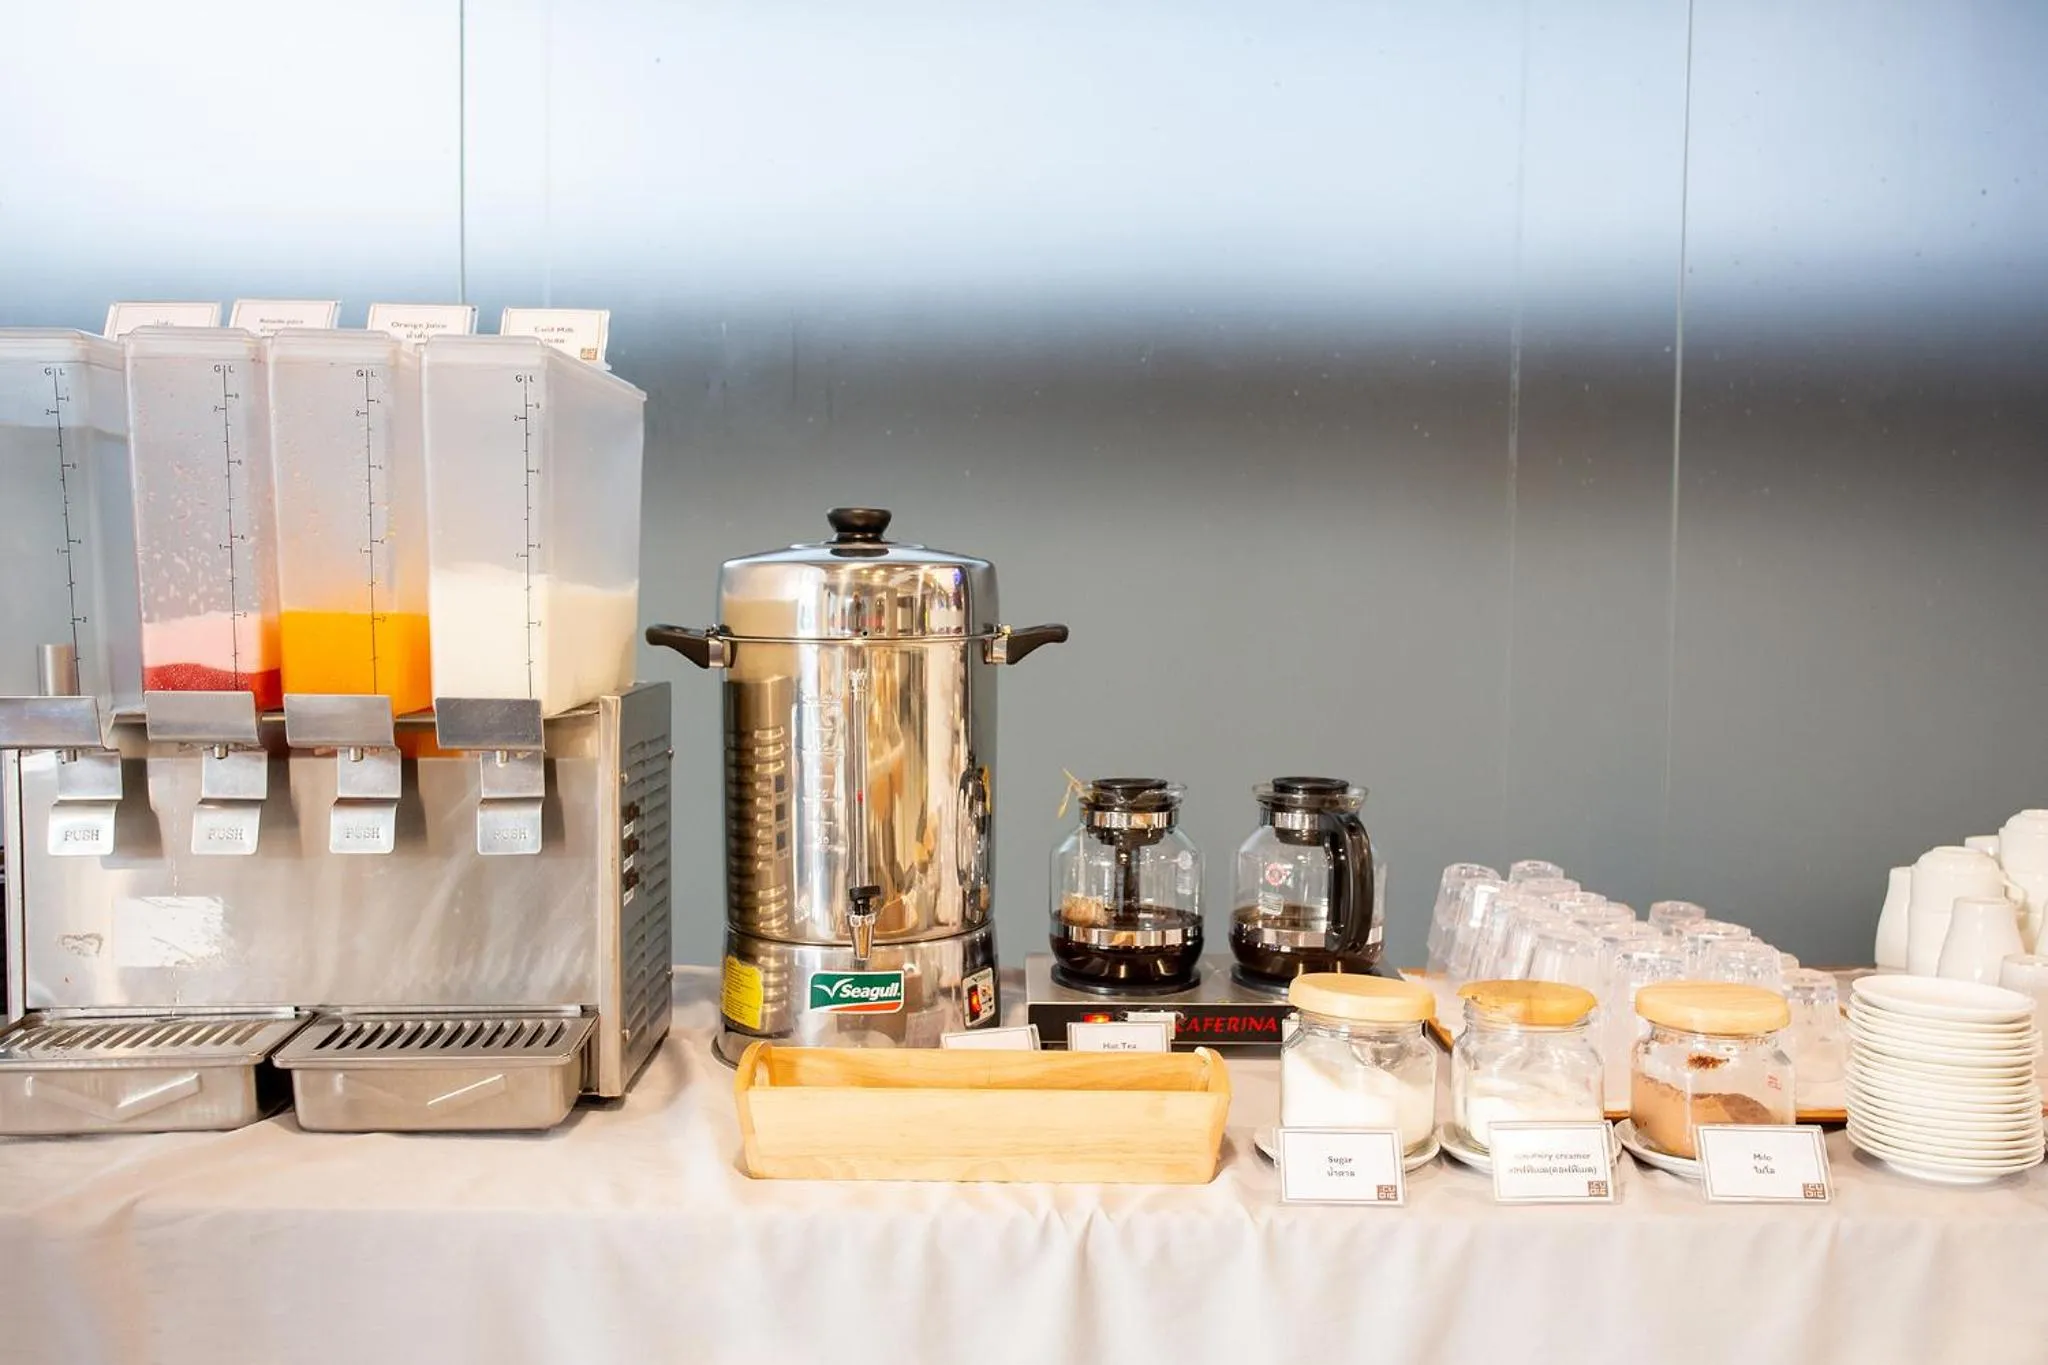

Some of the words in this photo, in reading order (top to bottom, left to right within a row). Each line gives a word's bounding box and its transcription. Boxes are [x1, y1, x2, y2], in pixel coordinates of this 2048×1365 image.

[44, 367, 52, 376] G
[214, 364, 221, 373] G
[229, 365, 234, 373] L
[356, 369, 363, 378] G
[371, 370, 376, 378] L
[515, 374, 523, 382] G
[63, 829, 100, 842] PUSH
[207, 828, 244, 841] PUSH
[344, 826, 381, 840] PUSH
[493, 827, 529, 840] PUSH
[1328, 1155, 1352, 1166] Sugar
[1555, 1152, 1591, 1161] creamer
[1753, 1153, 1773, 1161] Milo
